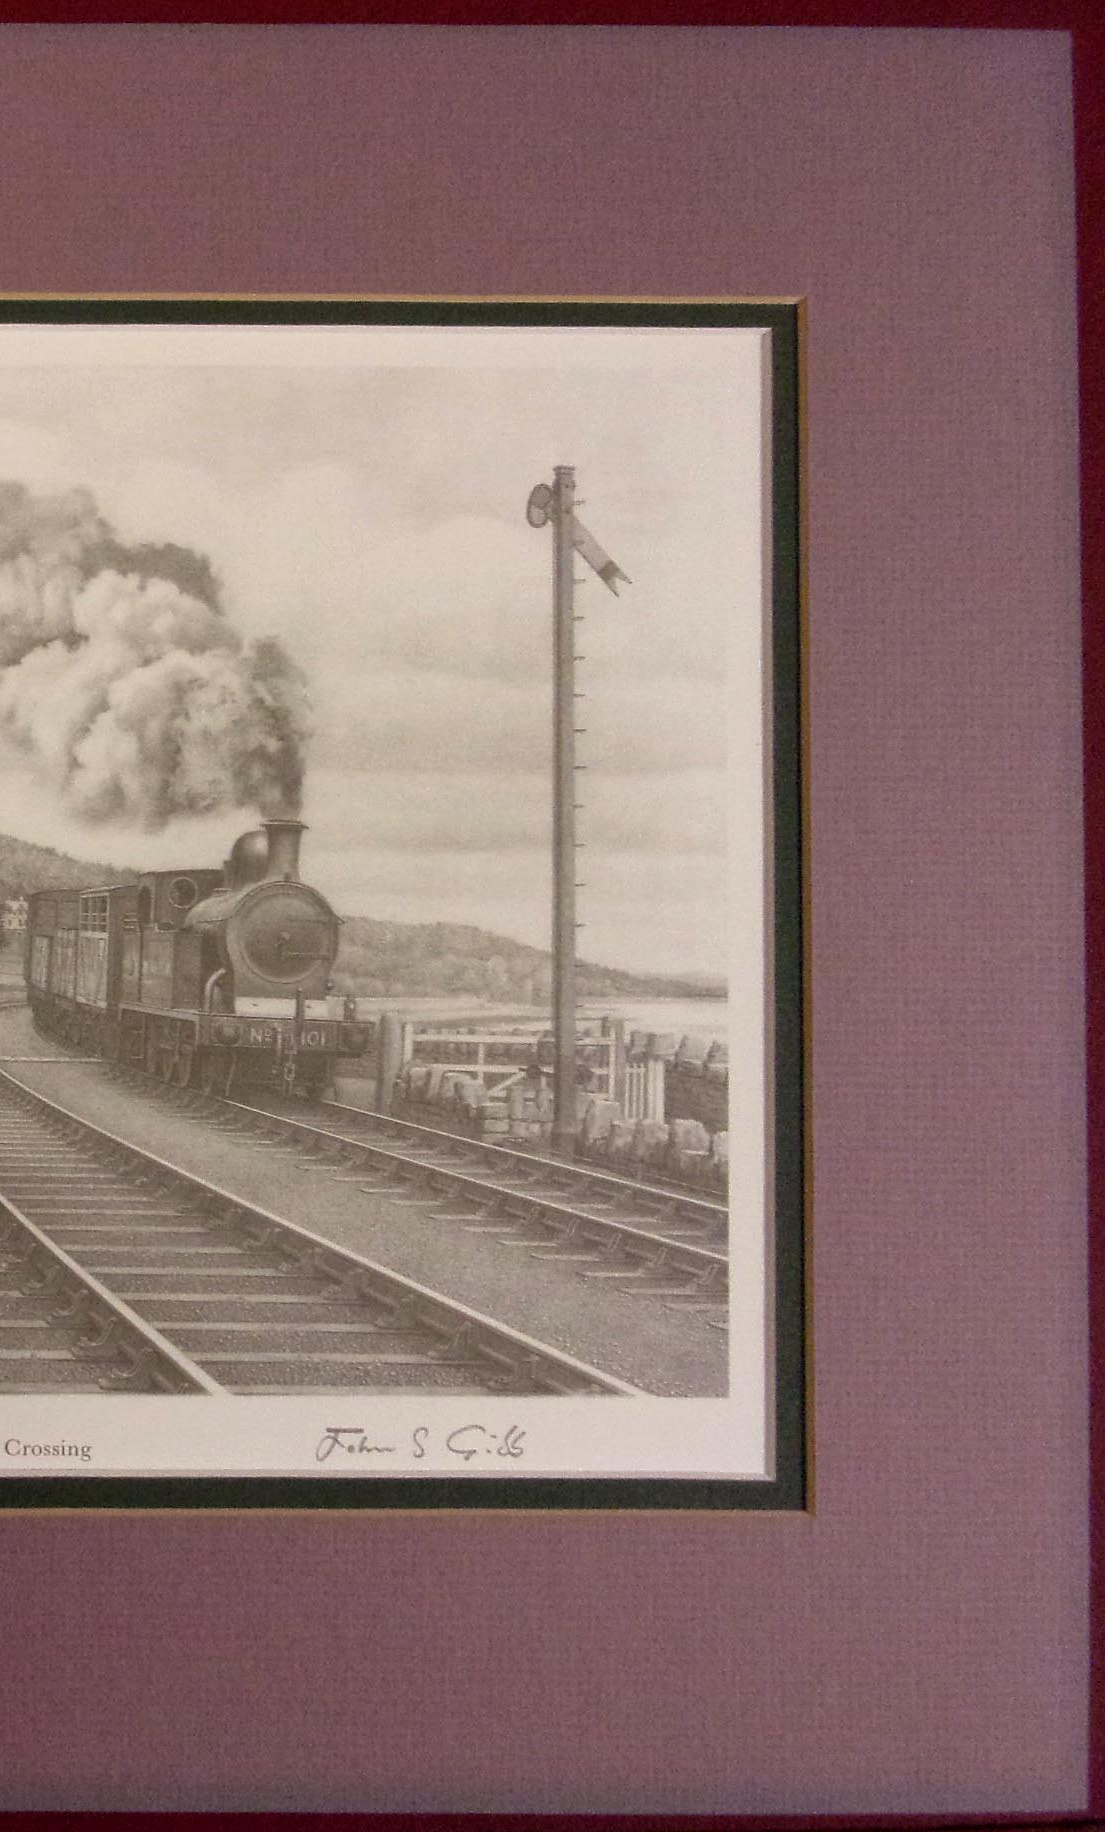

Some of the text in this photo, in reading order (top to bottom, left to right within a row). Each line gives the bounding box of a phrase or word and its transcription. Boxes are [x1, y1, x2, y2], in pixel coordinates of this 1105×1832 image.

[4, 1438, 92, 1462] Crossing
[316, 1427, 396, 1461] John
[413, 1426, 429, 1458] S
